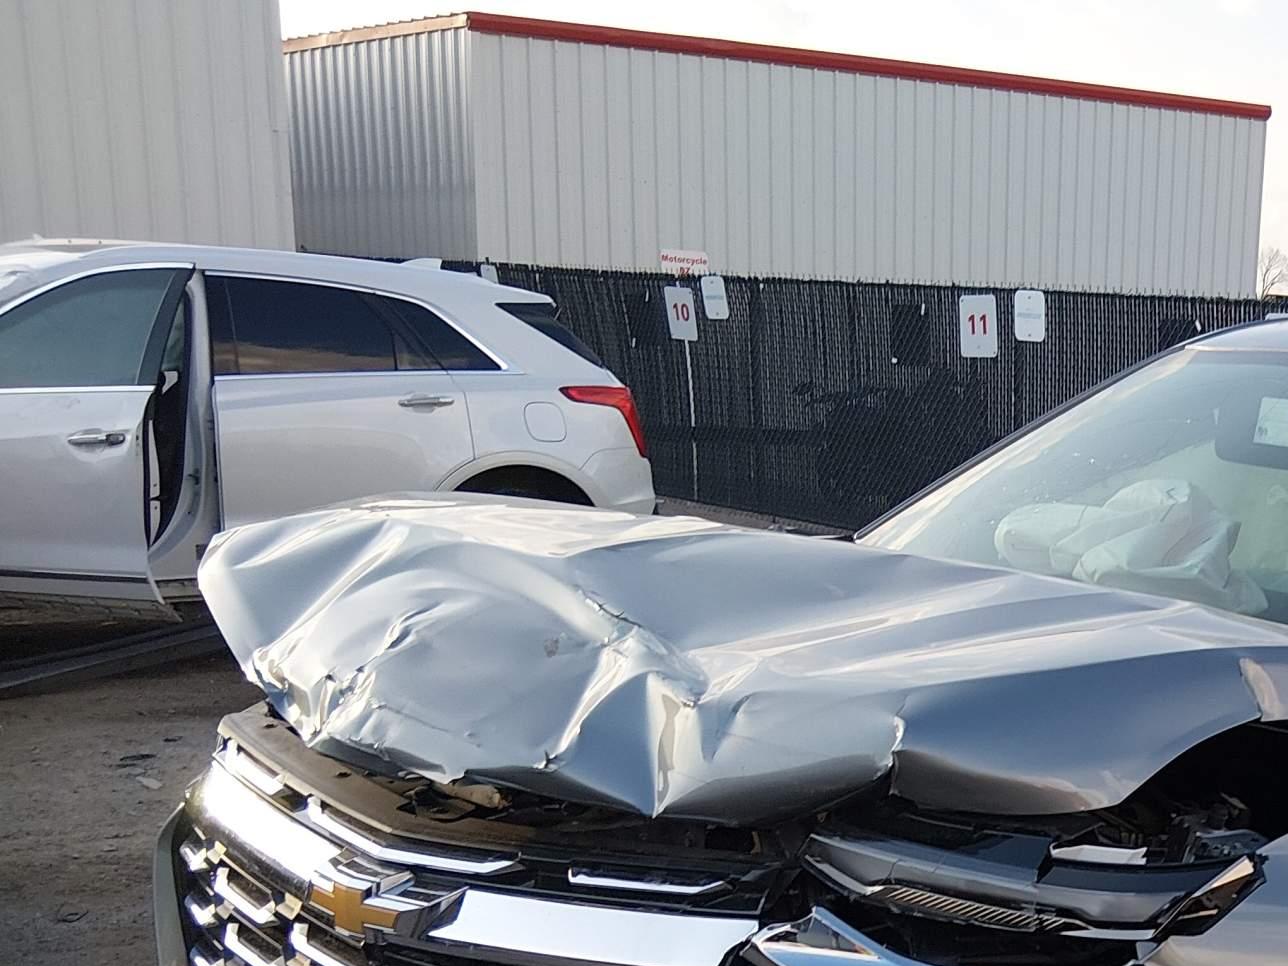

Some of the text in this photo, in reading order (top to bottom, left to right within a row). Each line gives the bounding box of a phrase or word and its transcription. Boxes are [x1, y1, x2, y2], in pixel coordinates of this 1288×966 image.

[661, 254, 707, 265] Motorcycle
[673, 303, 690, 322] 10
[968, 314, 987, 335] 11
